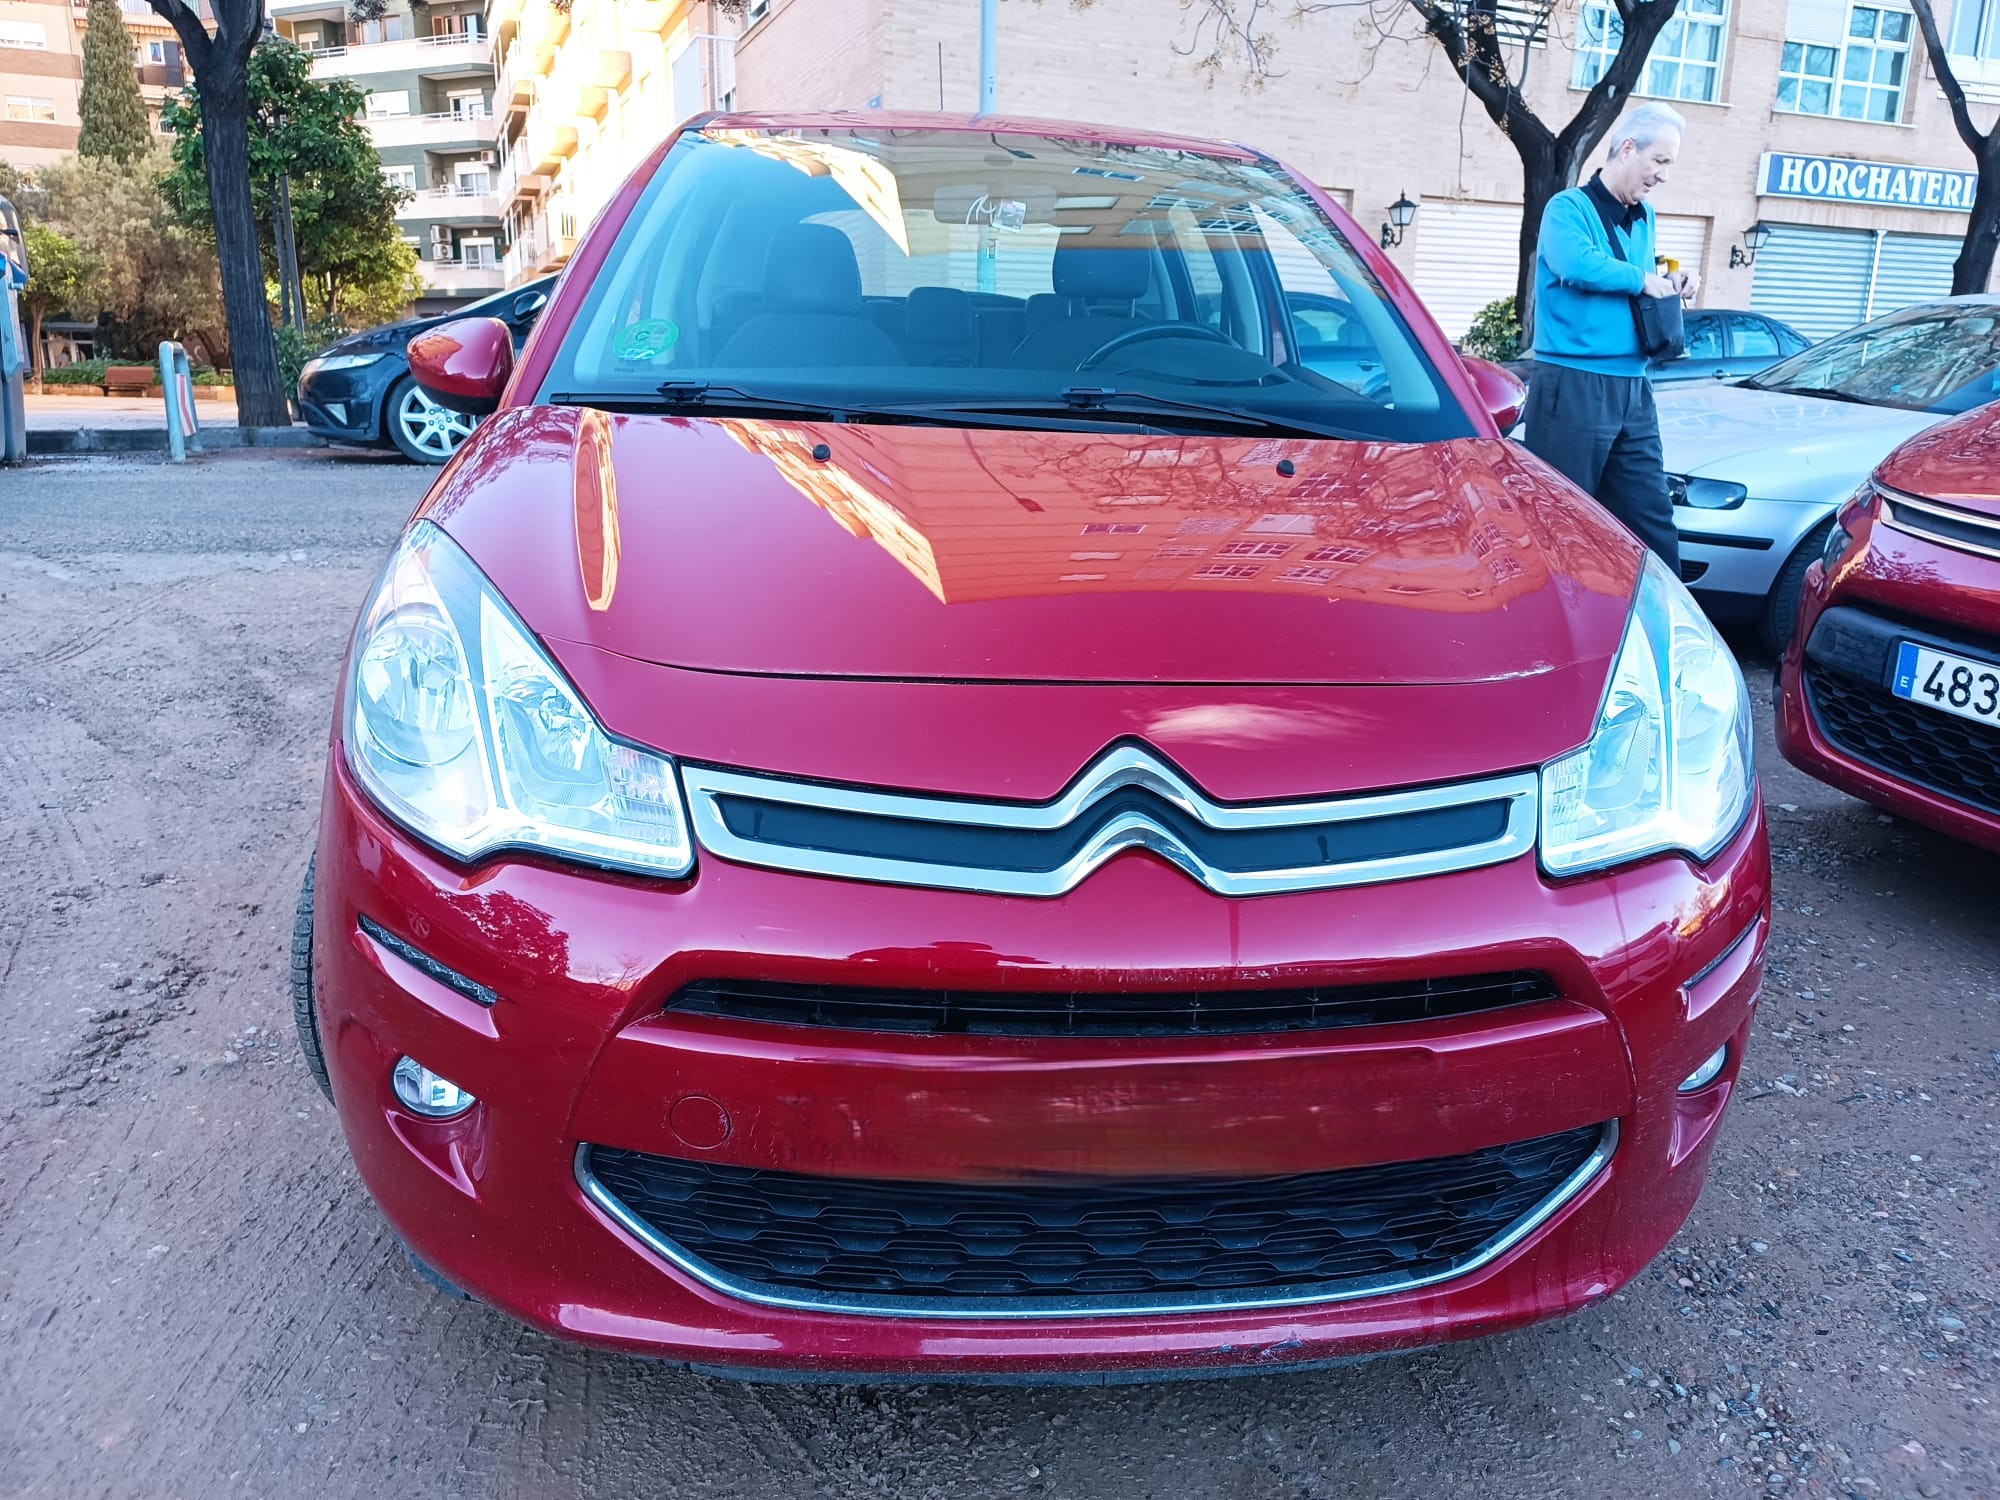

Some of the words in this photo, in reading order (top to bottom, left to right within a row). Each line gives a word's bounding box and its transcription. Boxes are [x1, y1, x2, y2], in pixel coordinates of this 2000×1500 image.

[1778, 157, 1977, 207] HORCHATERI
[1900, 676, 1909, 688] E
[1922, 660, 2000, 719] 483
